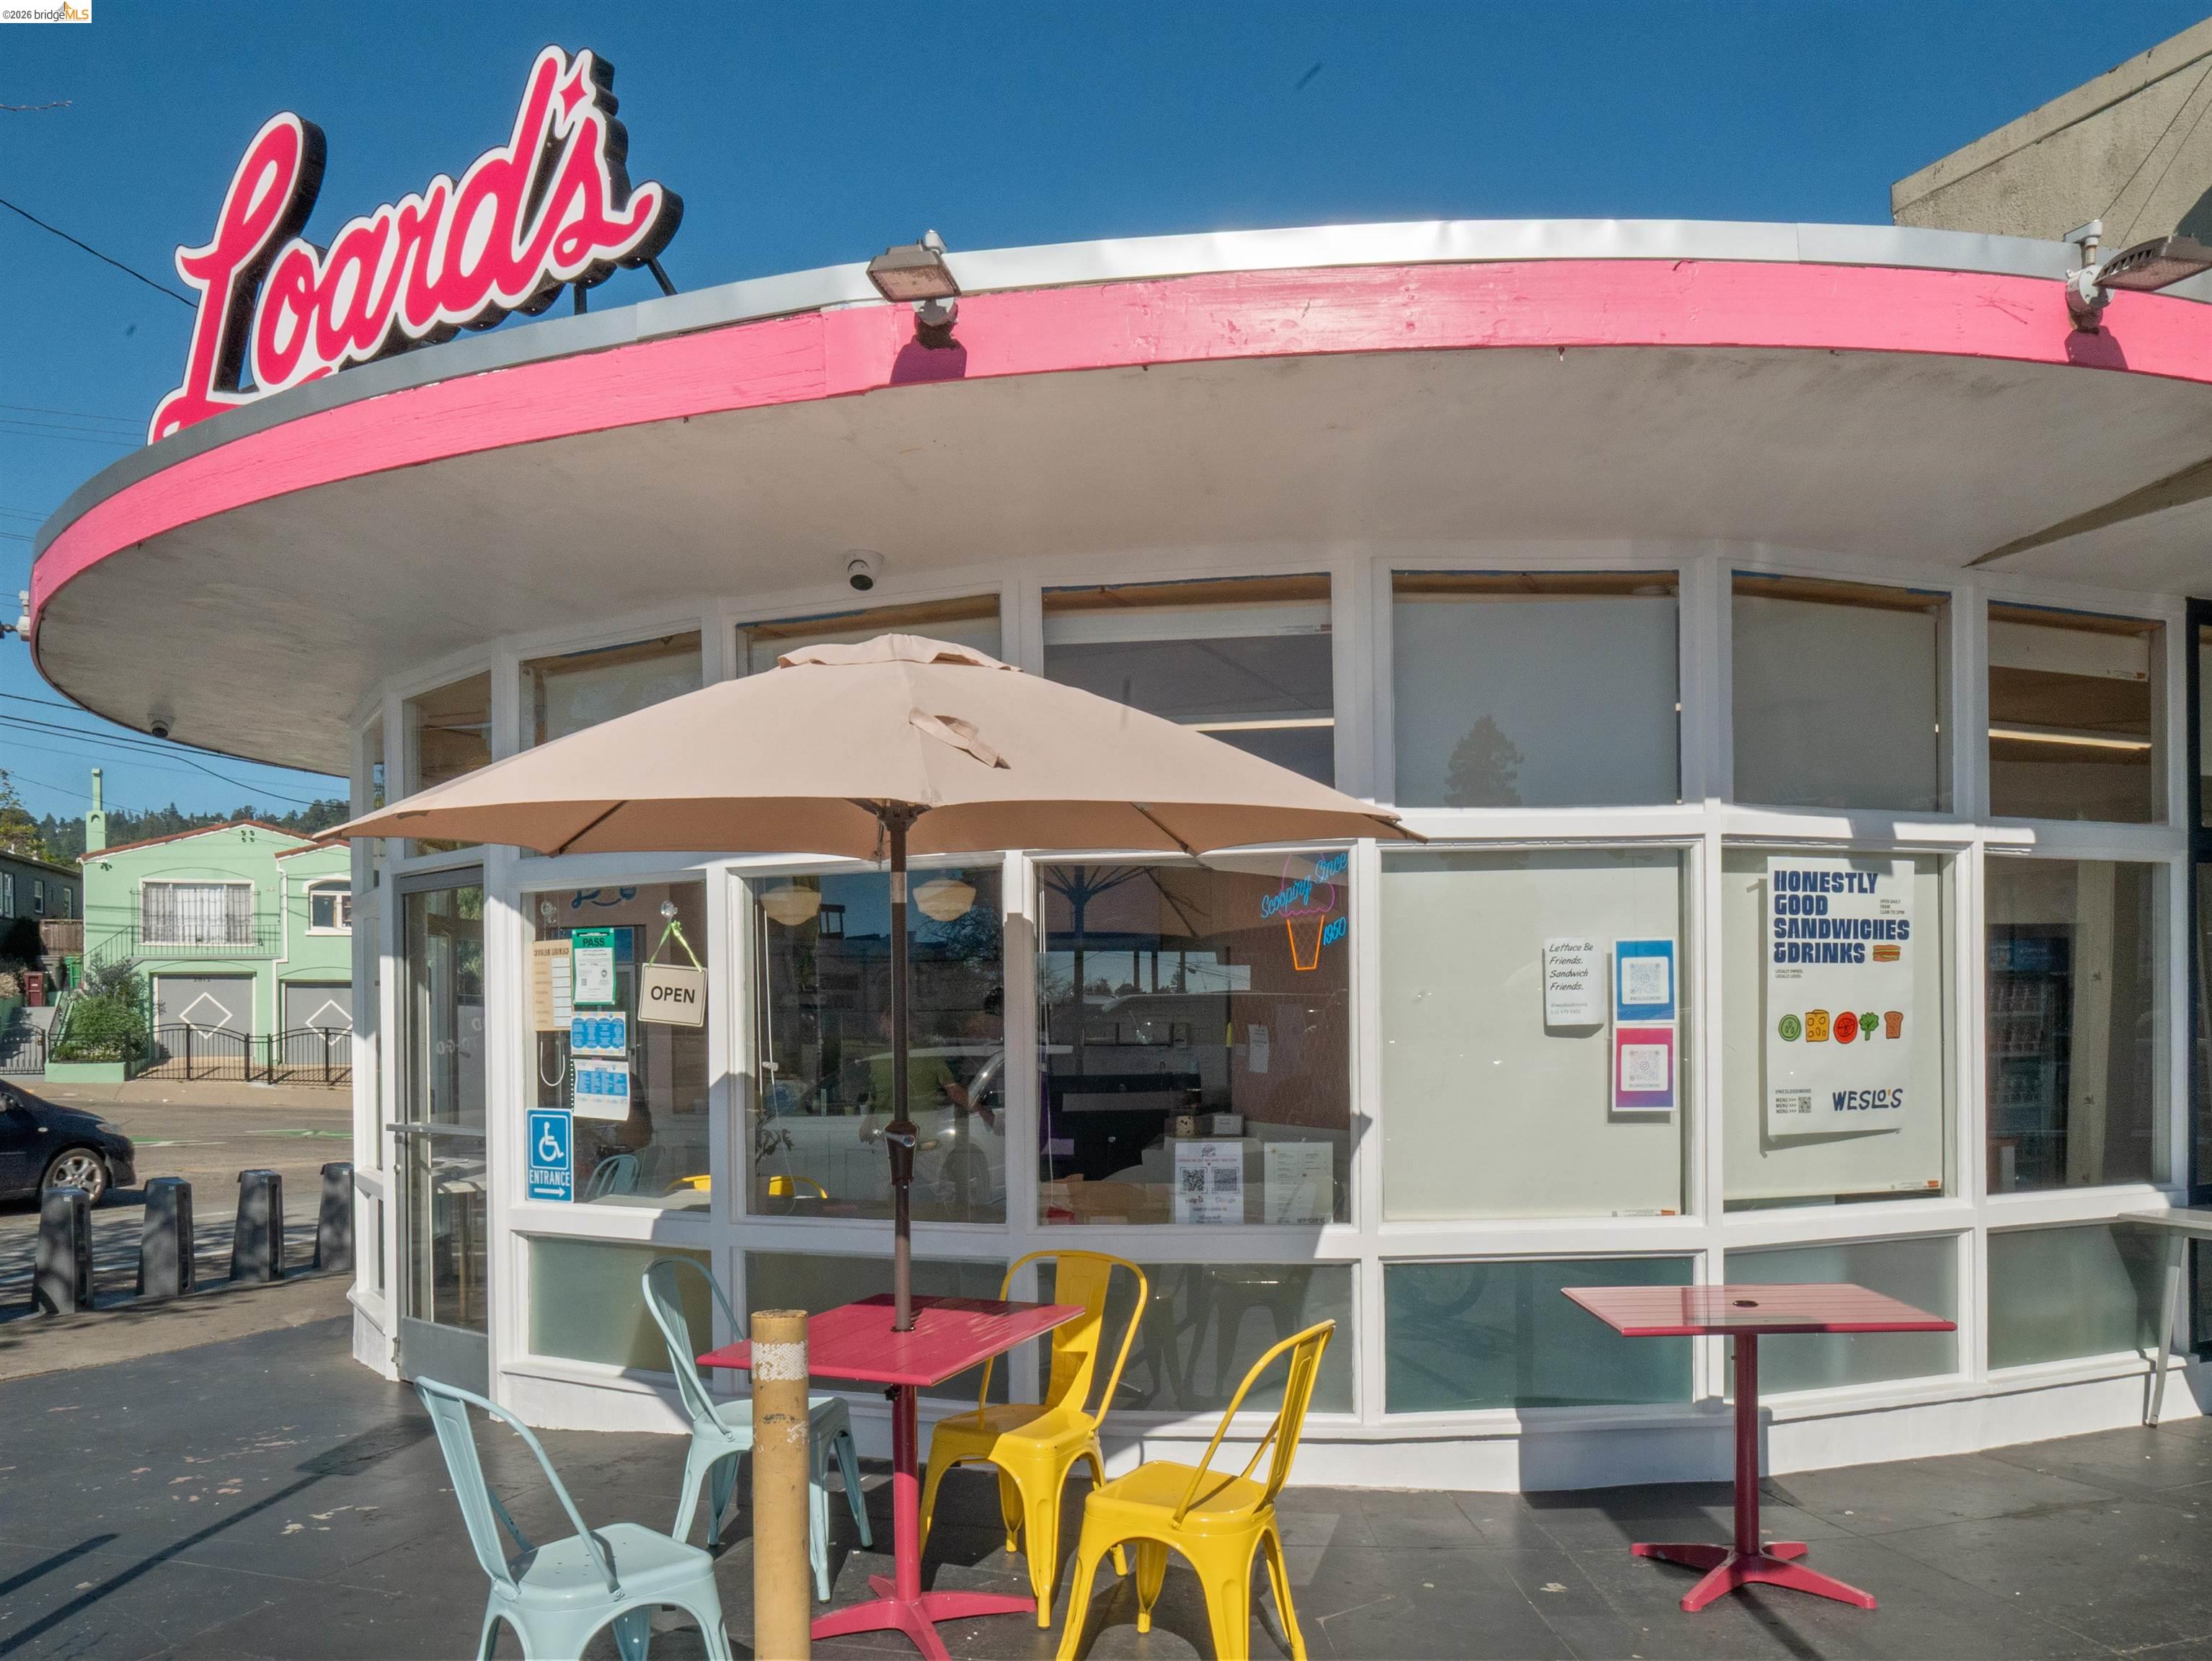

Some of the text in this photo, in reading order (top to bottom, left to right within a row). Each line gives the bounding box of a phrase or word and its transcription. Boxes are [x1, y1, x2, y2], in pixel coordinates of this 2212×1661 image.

[148, 45, 671, 445] Loard's
[1261, 853, 1348, 918] Scooping Since
[1774, 870, 1879, 894] HONESTLY
[1774, 894, 1828, 916] GOOD
[1323, 916, 1347, 945] 1950
[1774, 917, 1910, 940] SANDWICHES
[583, 938, 605, 947] PASS
[1549, 942, 1594, 952] Lettuce Be
[1774, 942, 1865, 963] &DRINKS
[1549, 954, 1583, 965] Friends.
[1549, 968, 1589, 978] Sandwich
[650, 985, 695, 1004] OPEN
[1549, 980, 1584, 991] Friends.
[1832, 1089, 1903, 1112] WESLO'S
[529, 1169, 570, 1186] ENTRANCE
